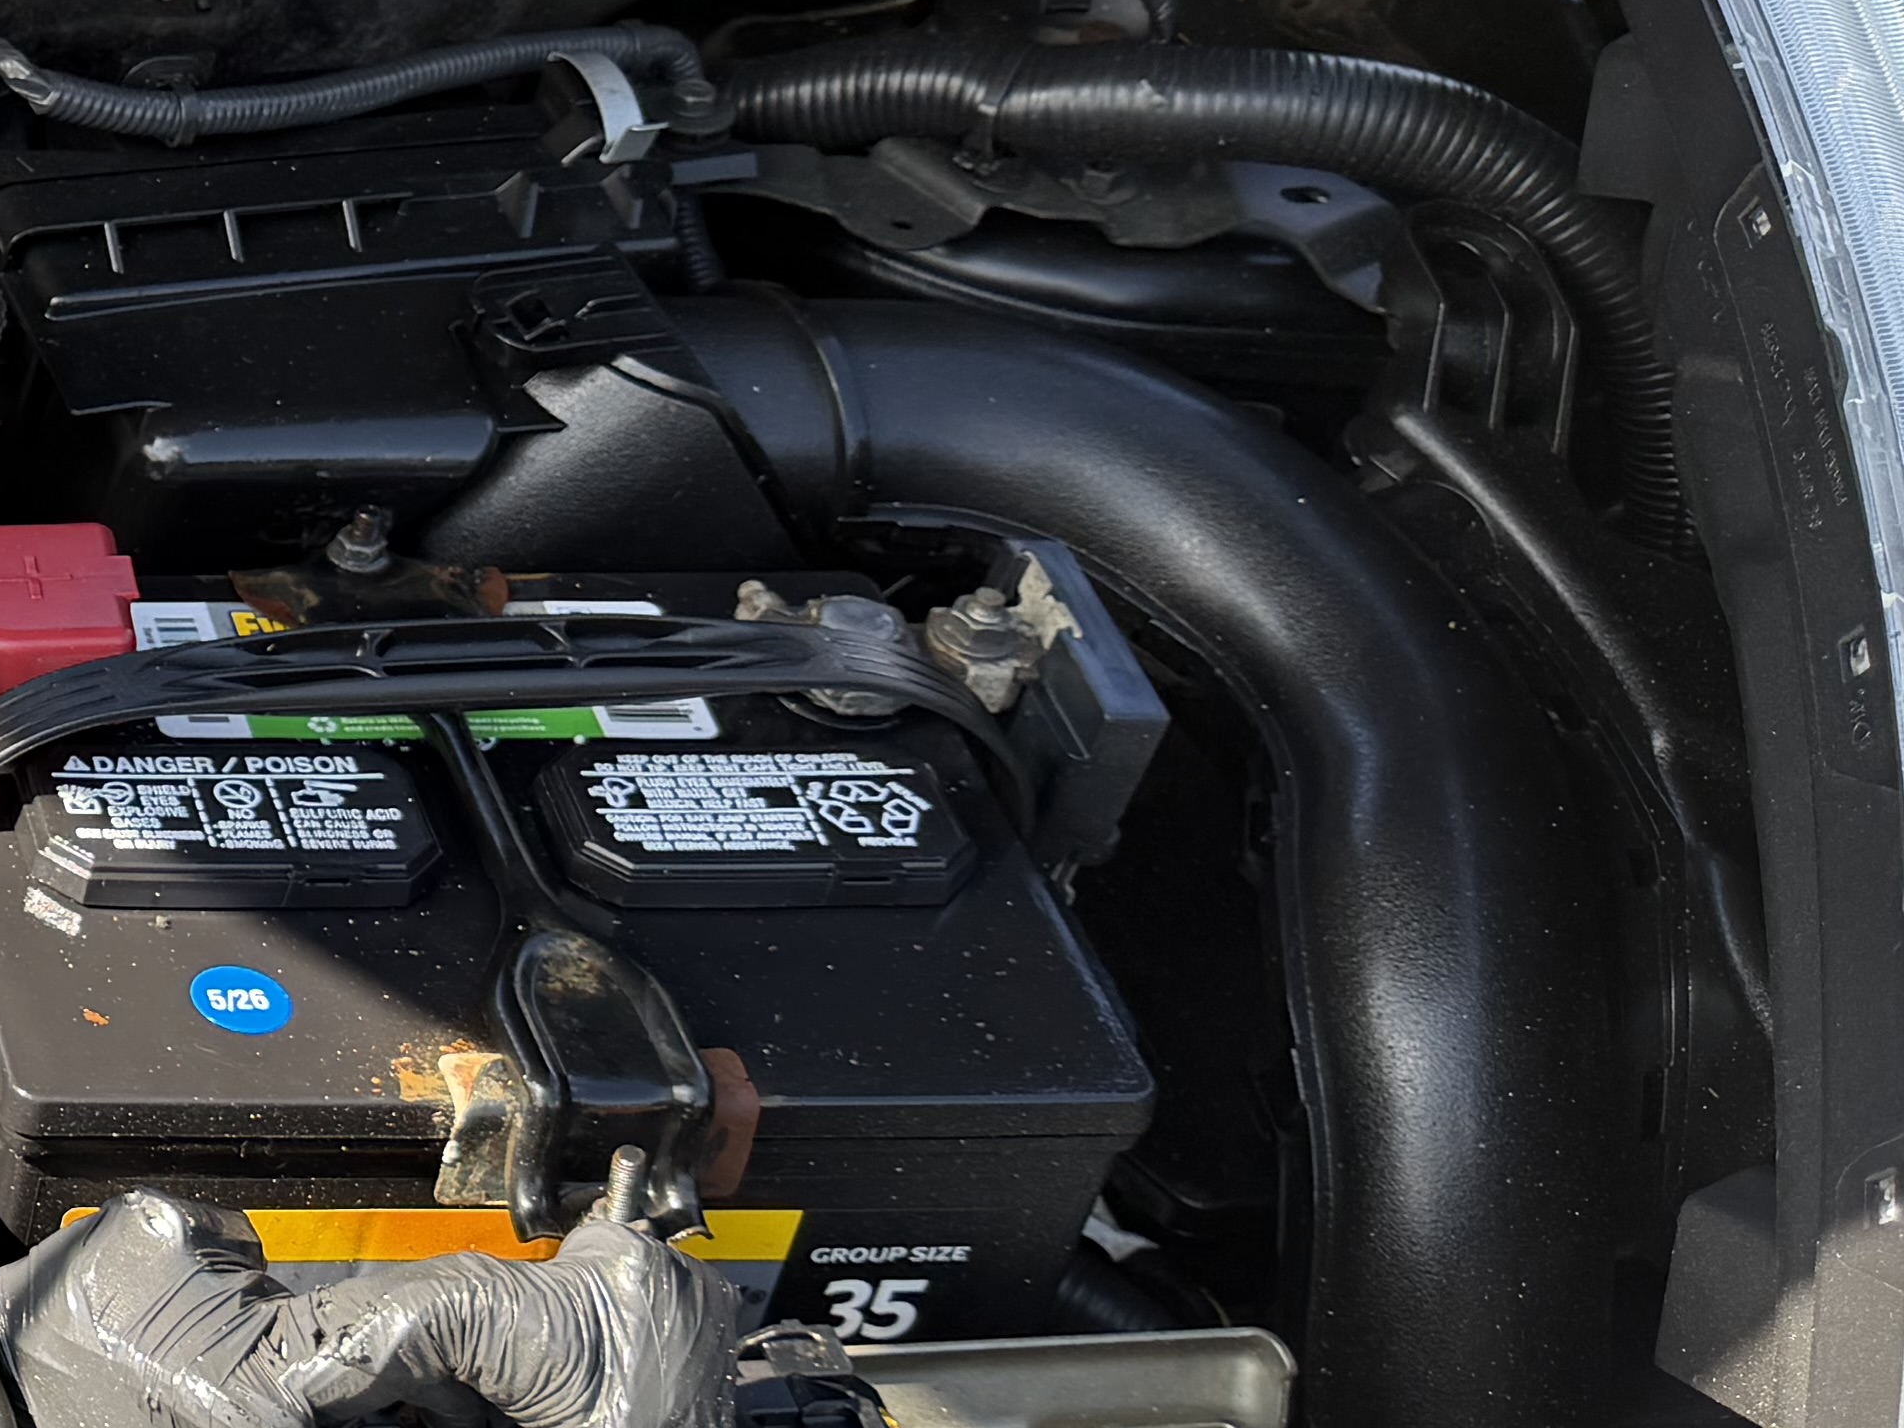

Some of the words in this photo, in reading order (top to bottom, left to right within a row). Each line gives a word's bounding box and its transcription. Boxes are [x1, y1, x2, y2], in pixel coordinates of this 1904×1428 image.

[92, 756, 216, 773] DANGER
[221, 757, 239, 773] /
[244, 755, 359, 774] POISON
[136, 784, 191, 796] SHIELD
[140, 795, 182, 806] EYES
[107, 806, 190, 818] EXPLOSIVE
[227, 808, 257, 820] NO
[288, 807, 364, 821] SULFURIC
[365, 808, 402, 821] ACID
[206, 988, 271, 1012] 5/26
[810, 1246, 907, 1264] GROUP
[909, 1245, 972, 1262] SIZE
[823, 1278, 931, 1340] 35
